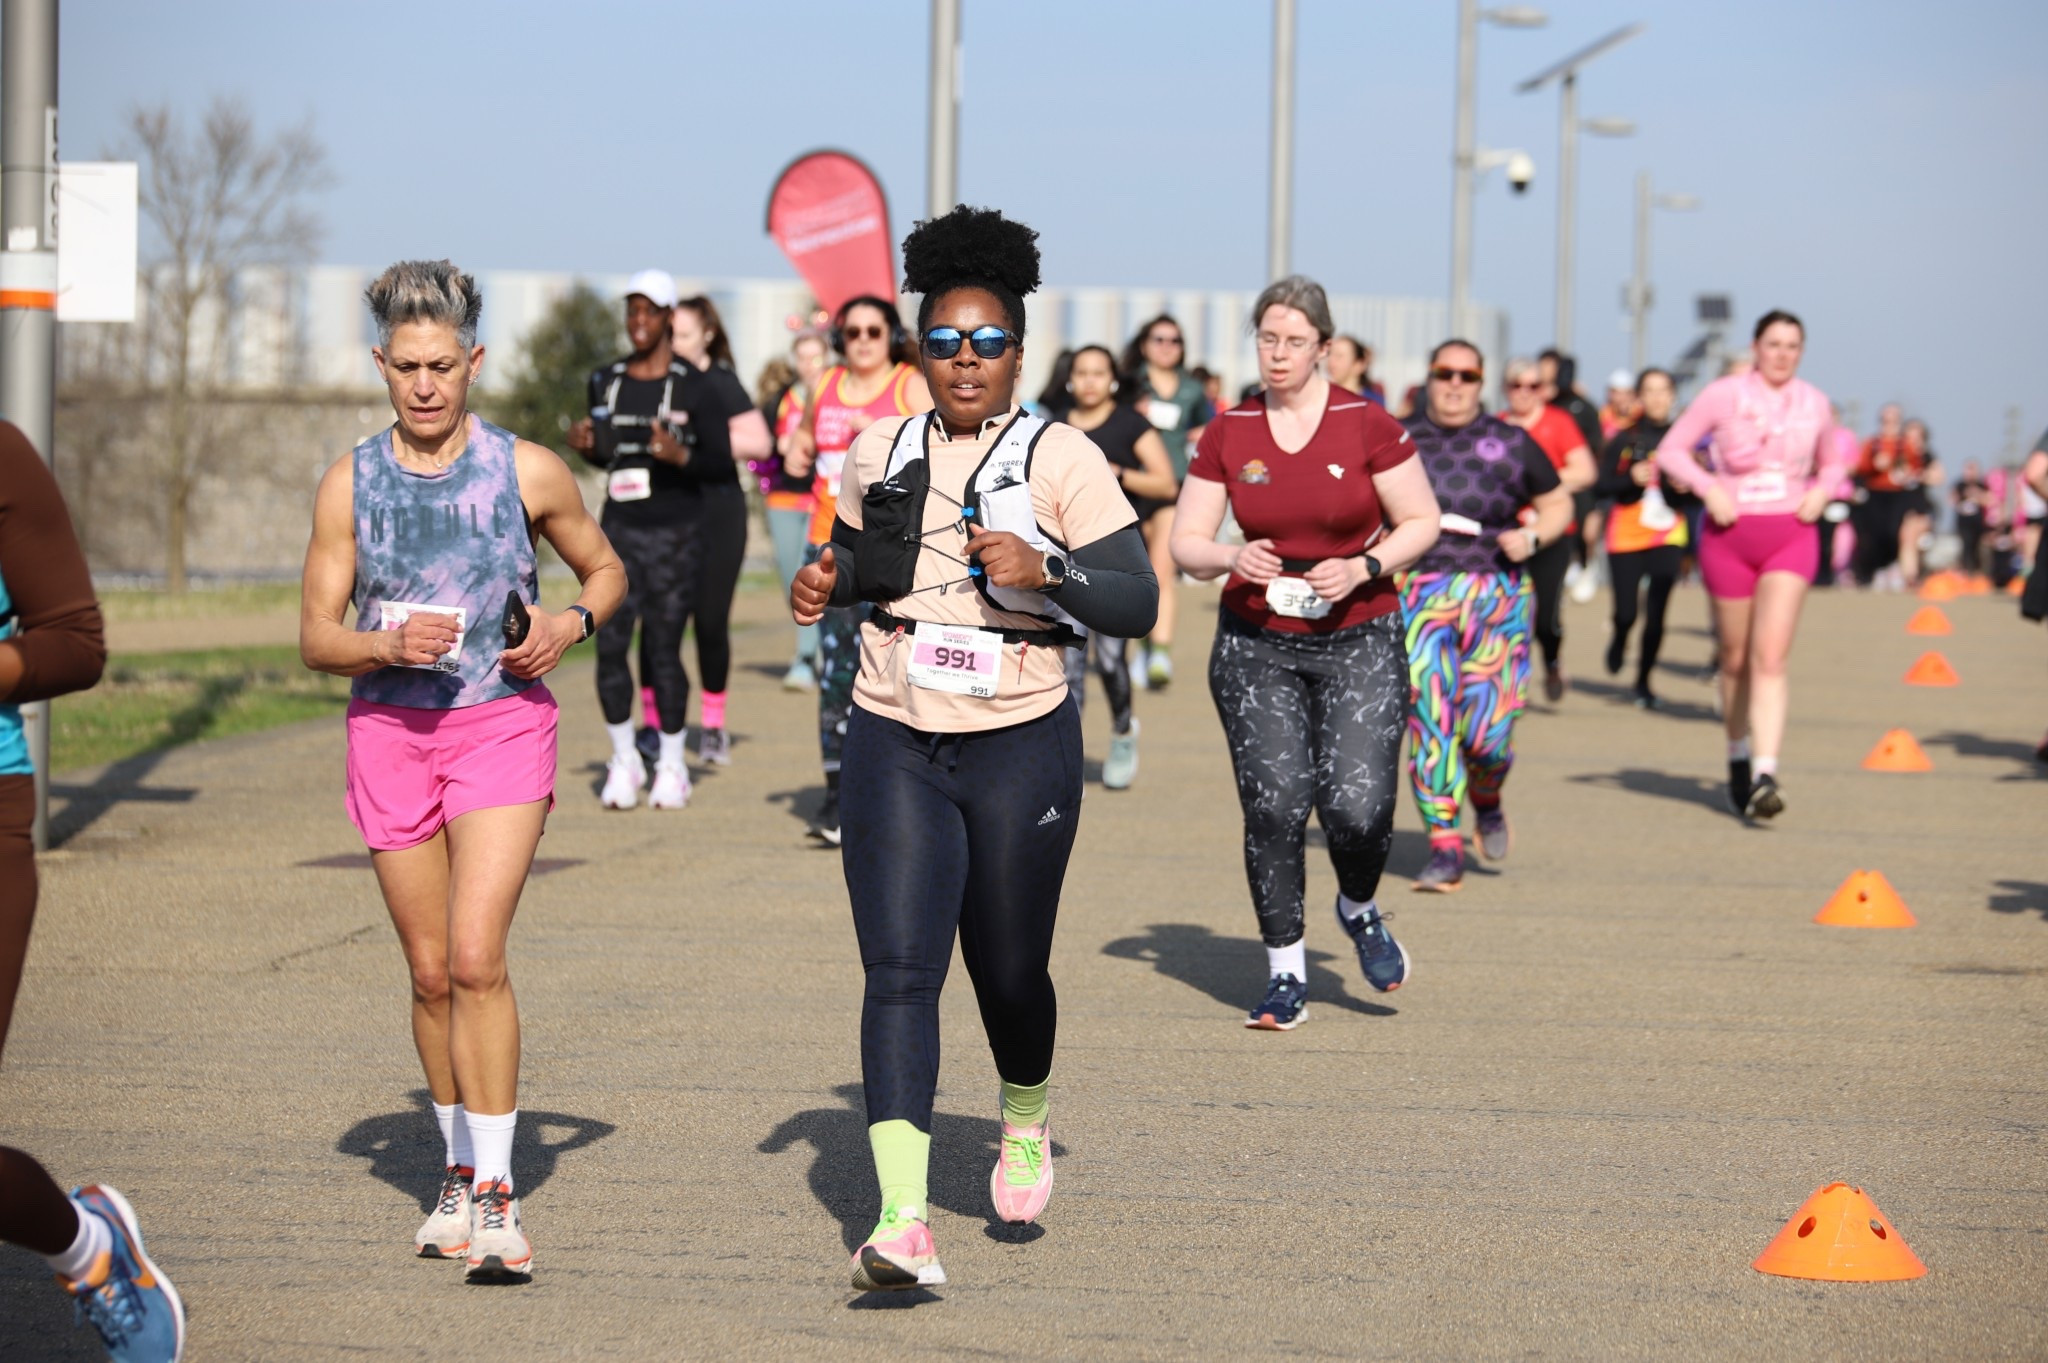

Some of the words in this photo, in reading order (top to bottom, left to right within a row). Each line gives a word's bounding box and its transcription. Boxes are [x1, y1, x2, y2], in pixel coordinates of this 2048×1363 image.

[1071, 569, 1090, 586] COL
[1283, 594, 1317, 609] 347
[935, 646, 976, 671] 991
[926, 667, 951, 677] Together
[961, 672, 979, 680] Thrive
[970, 686, 988, 696] 991
[1038, 814, 1061, 826] adidas
